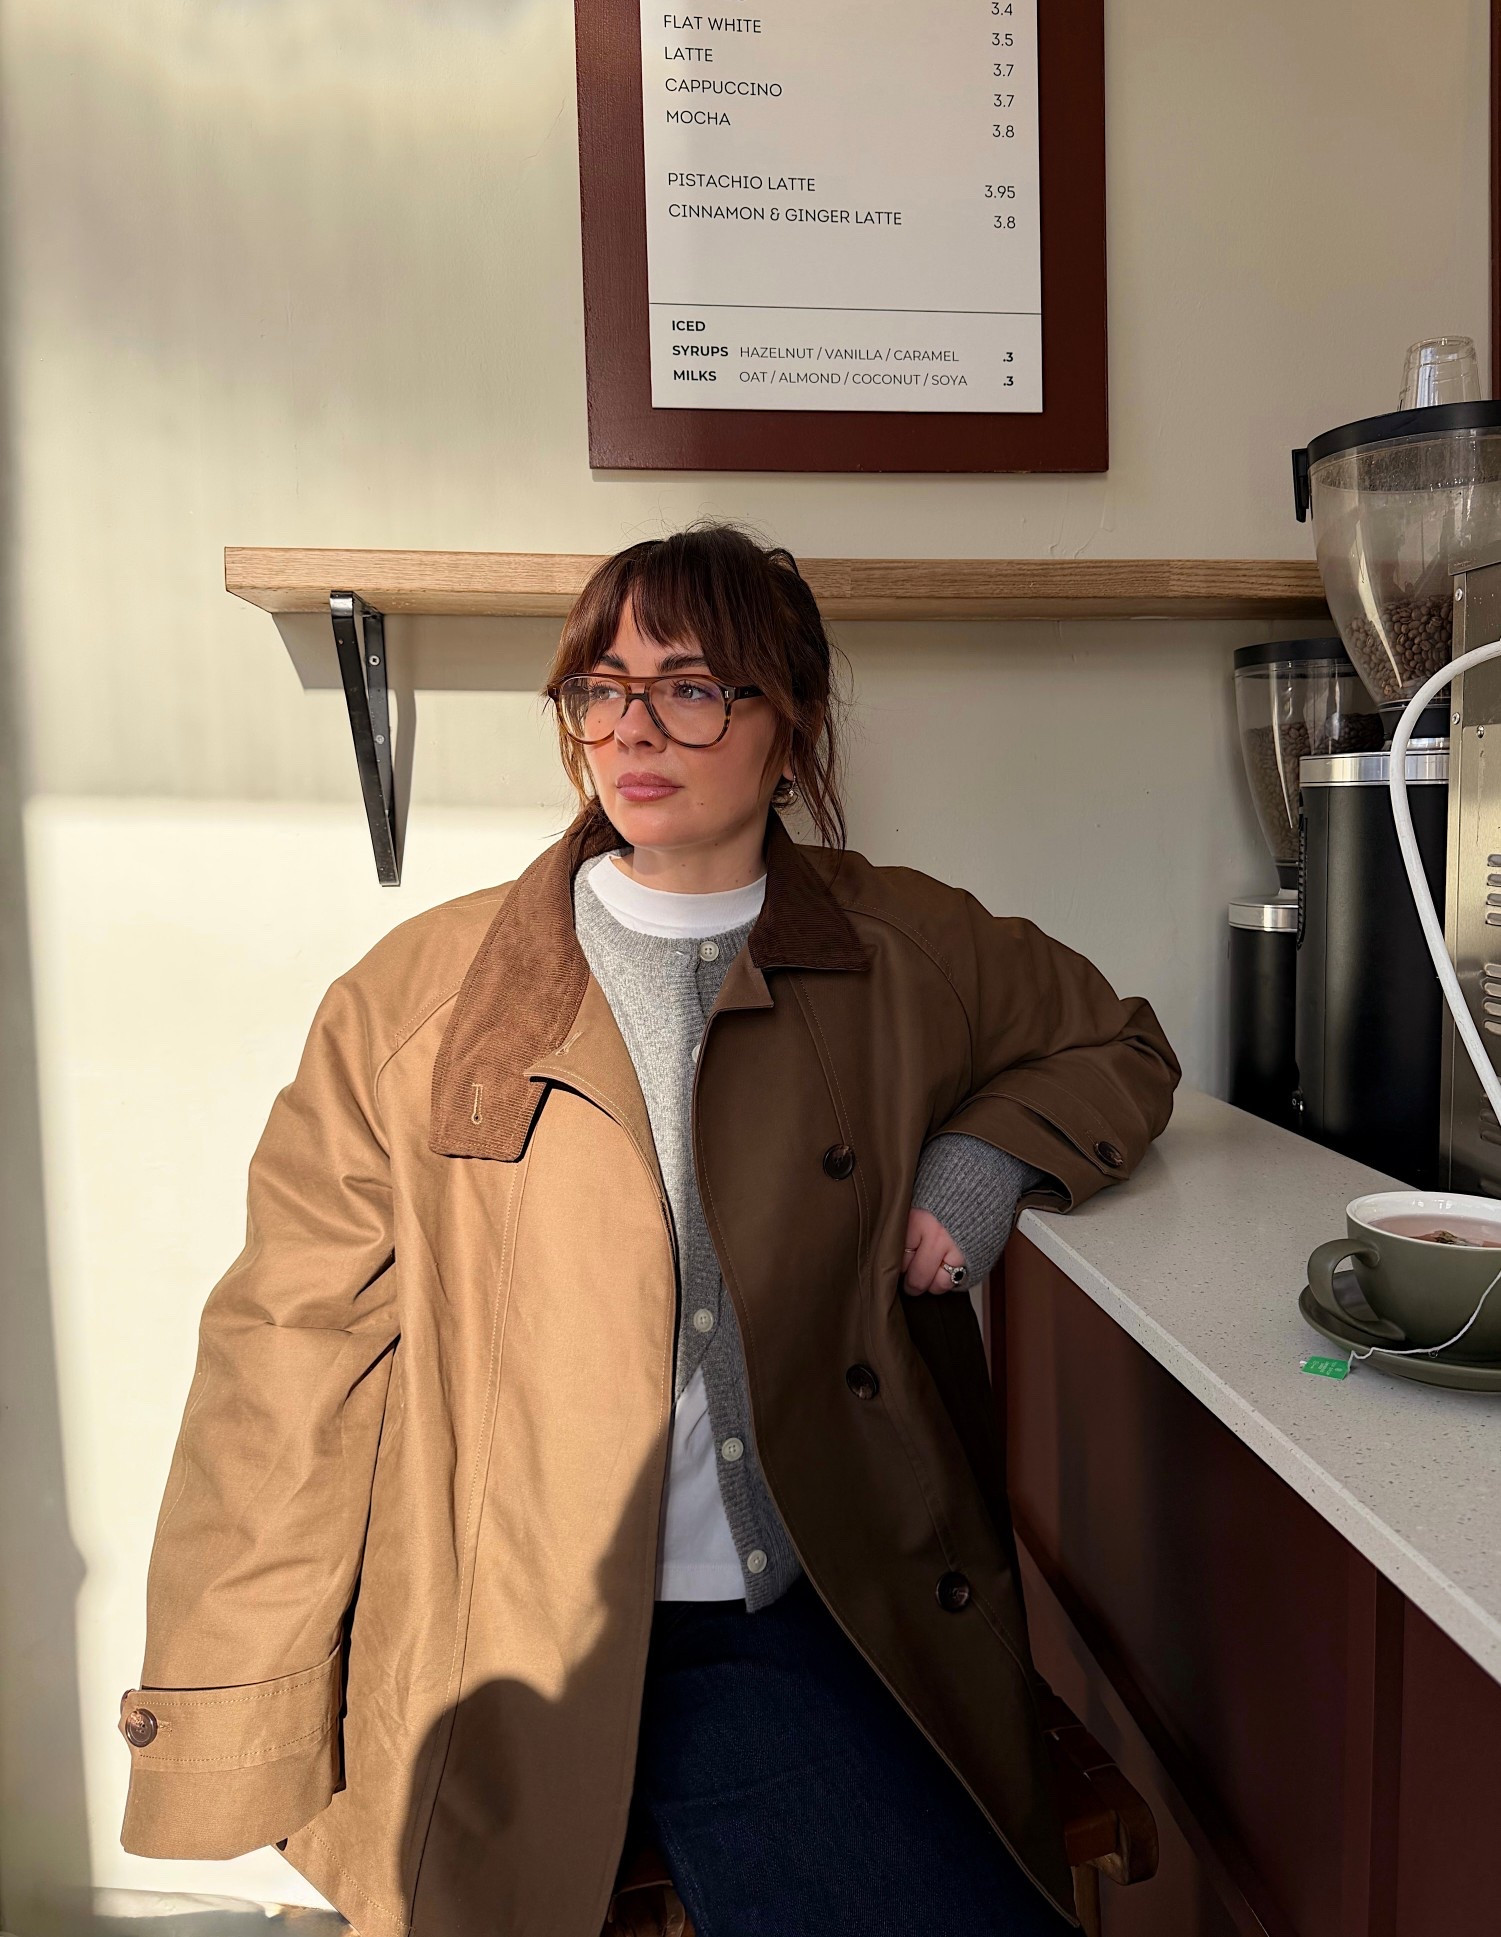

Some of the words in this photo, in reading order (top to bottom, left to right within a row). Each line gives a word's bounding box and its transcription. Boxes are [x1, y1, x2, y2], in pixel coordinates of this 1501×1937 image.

[990, 1, 1013, 16] 3.4
[663, 14, 704, 30] FLAT
[707, 16, 762, 33] WHITE
[991, 32, 1014, 47] 3.5
[664, 46, 714, 63] LATTE
[992, 63, 1015, 77] 3.7
[664, 77, 783, 98] CAPPUCCINO
[993, 93, 1015, 108] 3.7
[666, 109, 732, 127] MOCHA
[992, 124, 1015, 139] 3.8
[667, 172, 763, 190] PISTACHIO
[768, 176, 816, 192] LATTE
[984, 184, 1016, 199] 3.95
[668, 203, 765, 221] CINNAMON
[769, 207, 781, 222] &
[784, 207, 851, 224] GINGER
[855, 210, 902, 226] LATTE
[993, 215, 1016, 230] 3.8
[671, 319, 706, 332] ICED
[672, 344, 729, 358] SYRUPS
[740, 346, 815, 360] HAZELNUT
[824, 348, 883, 361] VANILLA
[893, 349, 960, 362] CARAMEL
[1002, 351, 1015, 363] .3
[673, 369, 717, 382] MILKS
[739, 371, 768, 383] OAT
[778, 371, 841, 385] ALMOND
[851, 373, 922, 386] COCONUT
[931, 374, 968, 387] SOYA
[1002, 375, 1015, 387] .3
